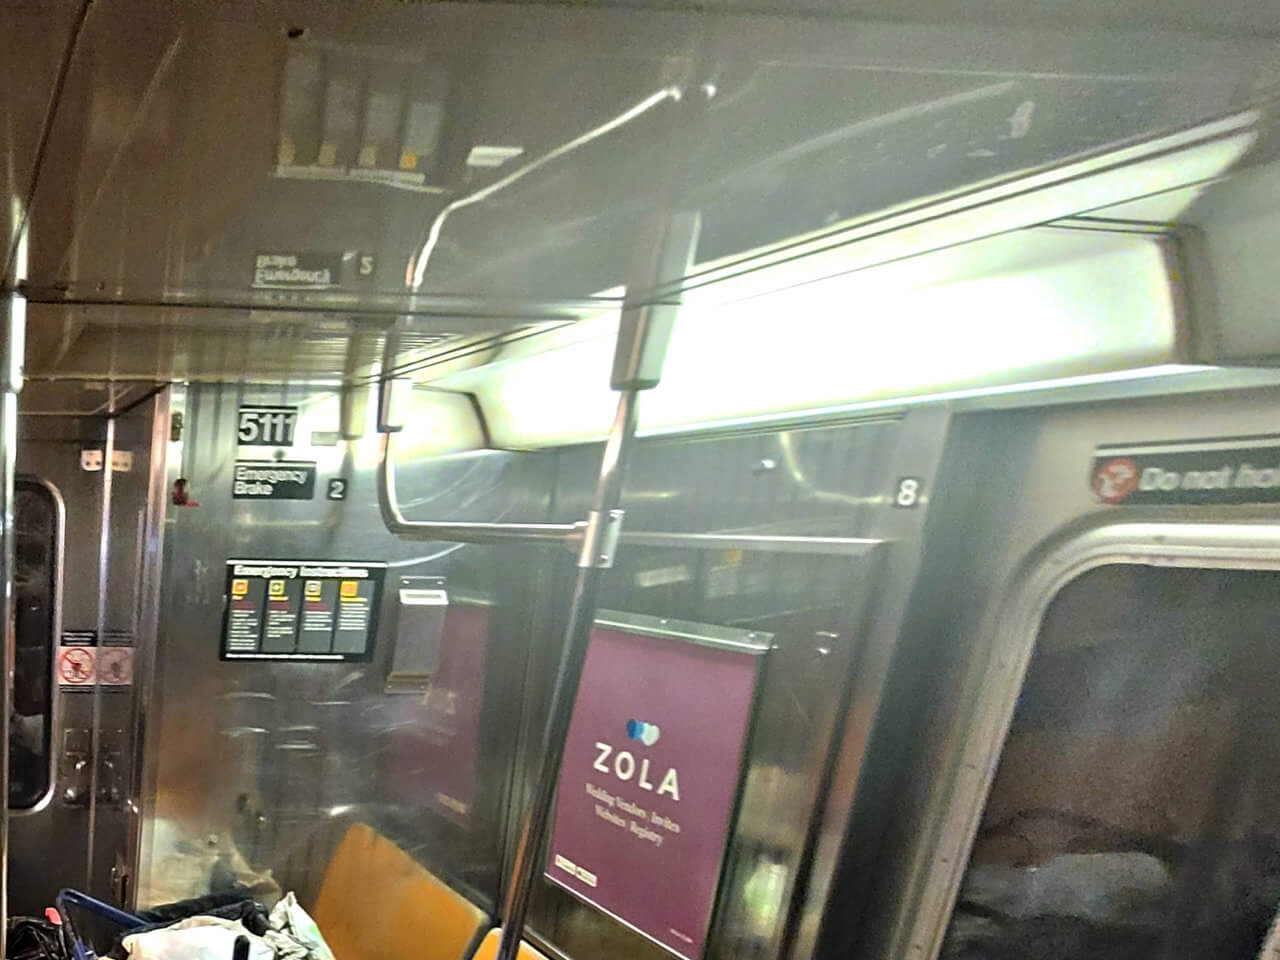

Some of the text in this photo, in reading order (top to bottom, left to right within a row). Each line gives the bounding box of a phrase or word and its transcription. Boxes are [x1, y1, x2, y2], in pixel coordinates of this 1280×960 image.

[238, 412, 298, 442] 5111
[235, 467, 308, 484] Emergency
[1138, 461, 1280, 491] Do not ho
[234, 481, 274, 496] Brake
[329, 480, 345, 499] 2
[896, 479, 918, 506] 8
[234, 564, 299, 579] Emergency
[593, 741, 680, 801] ZOLA
